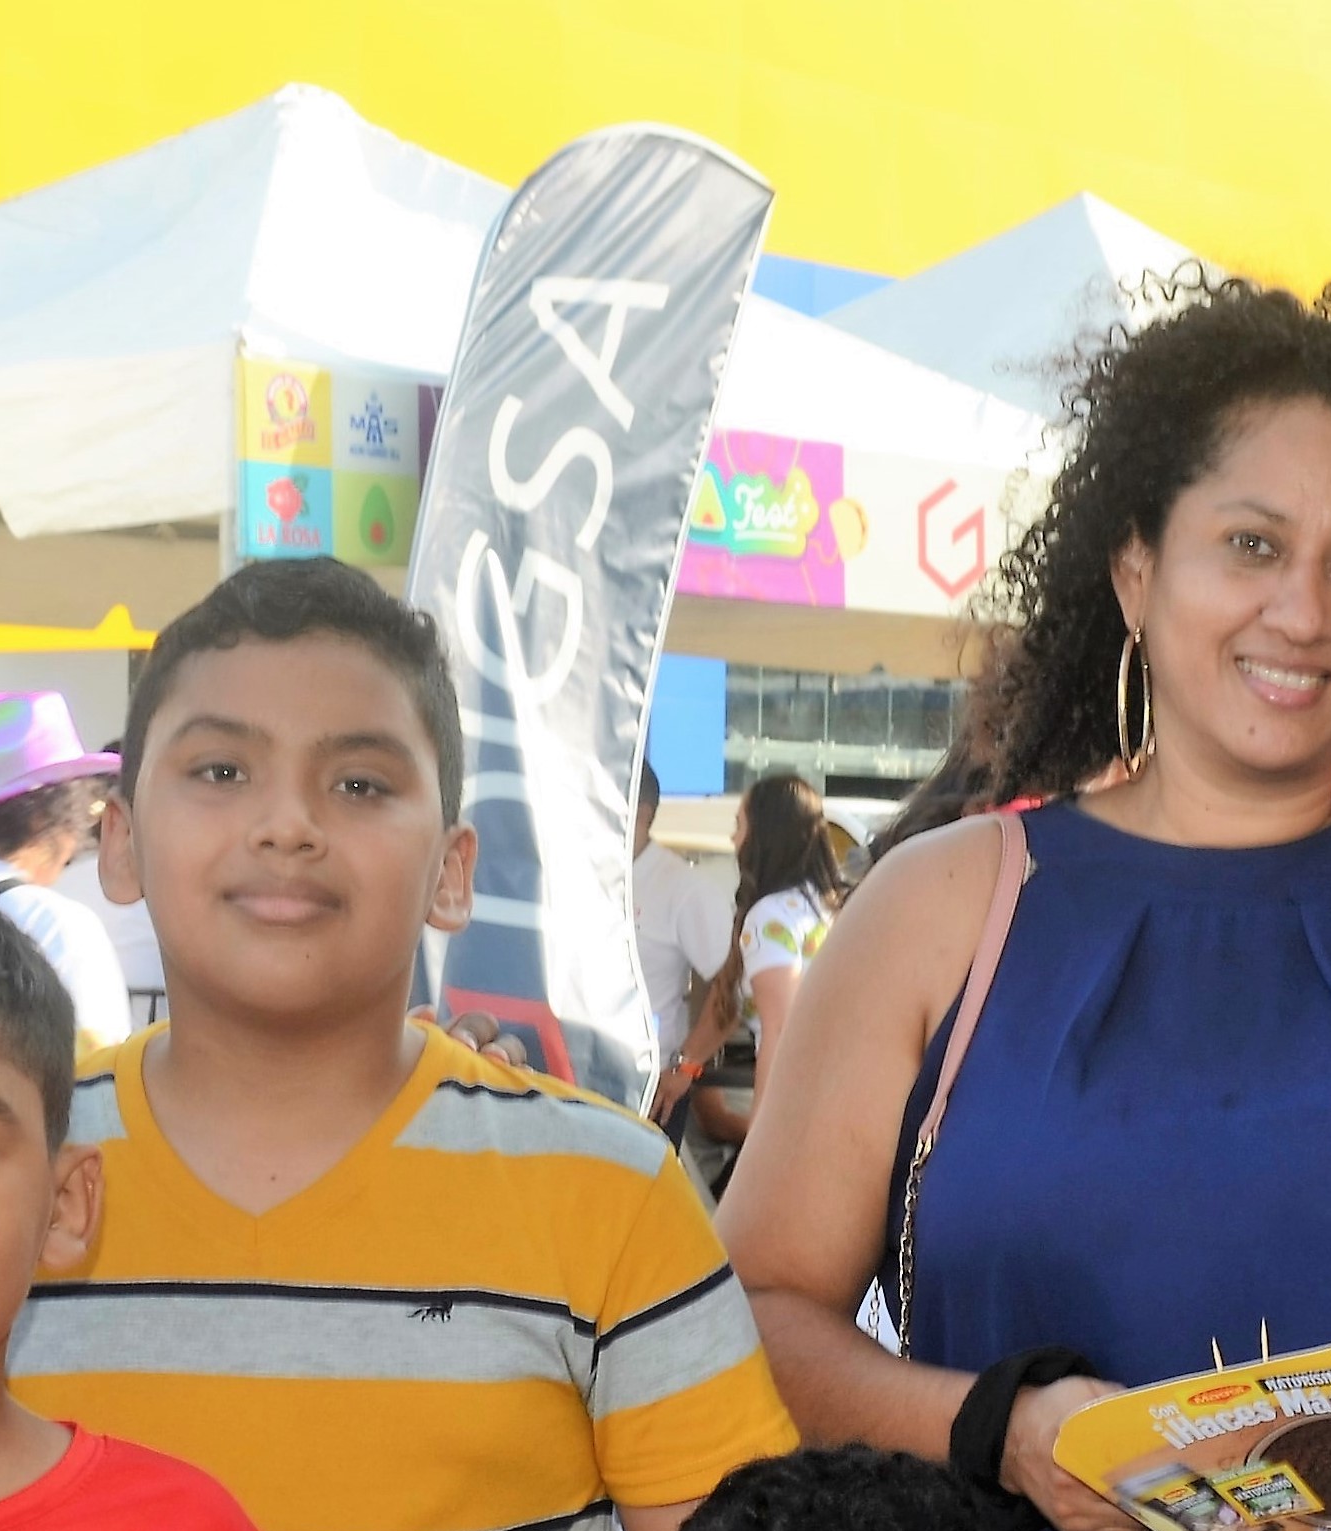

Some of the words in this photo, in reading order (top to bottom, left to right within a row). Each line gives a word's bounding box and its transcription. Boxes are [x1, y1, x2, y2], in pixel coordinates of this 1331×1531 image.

[732, 482, 798, 531] Fest
[257, 520, 277, 545] LA
[282, 521, 322, 547] ROSA
